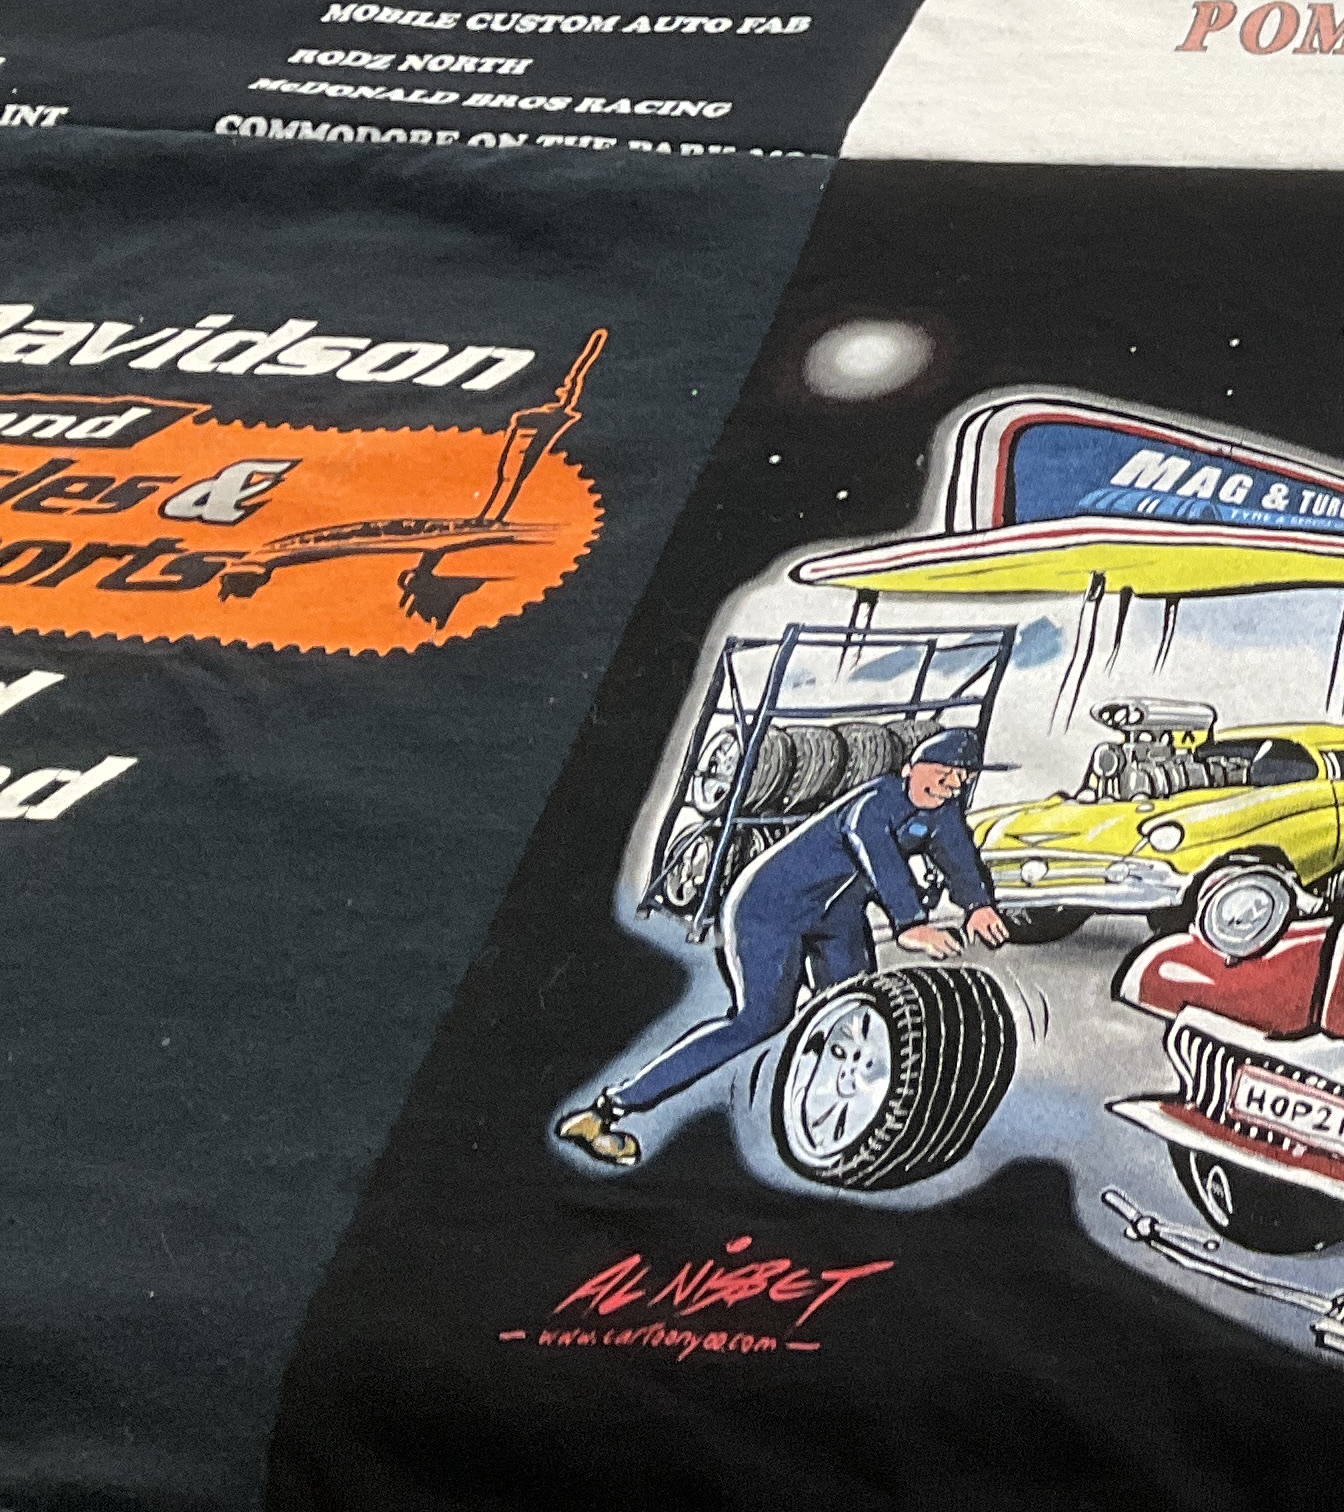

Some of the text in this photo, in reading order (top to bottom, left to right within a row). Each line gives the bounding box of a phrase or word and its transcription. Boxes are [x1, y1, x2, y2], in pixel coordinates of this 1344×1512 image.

[321, 2, 812, 36] MOBILE CUSTOM AUTO FAB
[287, 47, 534, 78] RODZ NORTH
[248, 76, 733, 120] McDONALD BROS RACING
[1110, 449, 1254, 508] MAG
[1261, 478, 1290, 512] &
[551, 1253, 652, 1317] AL
